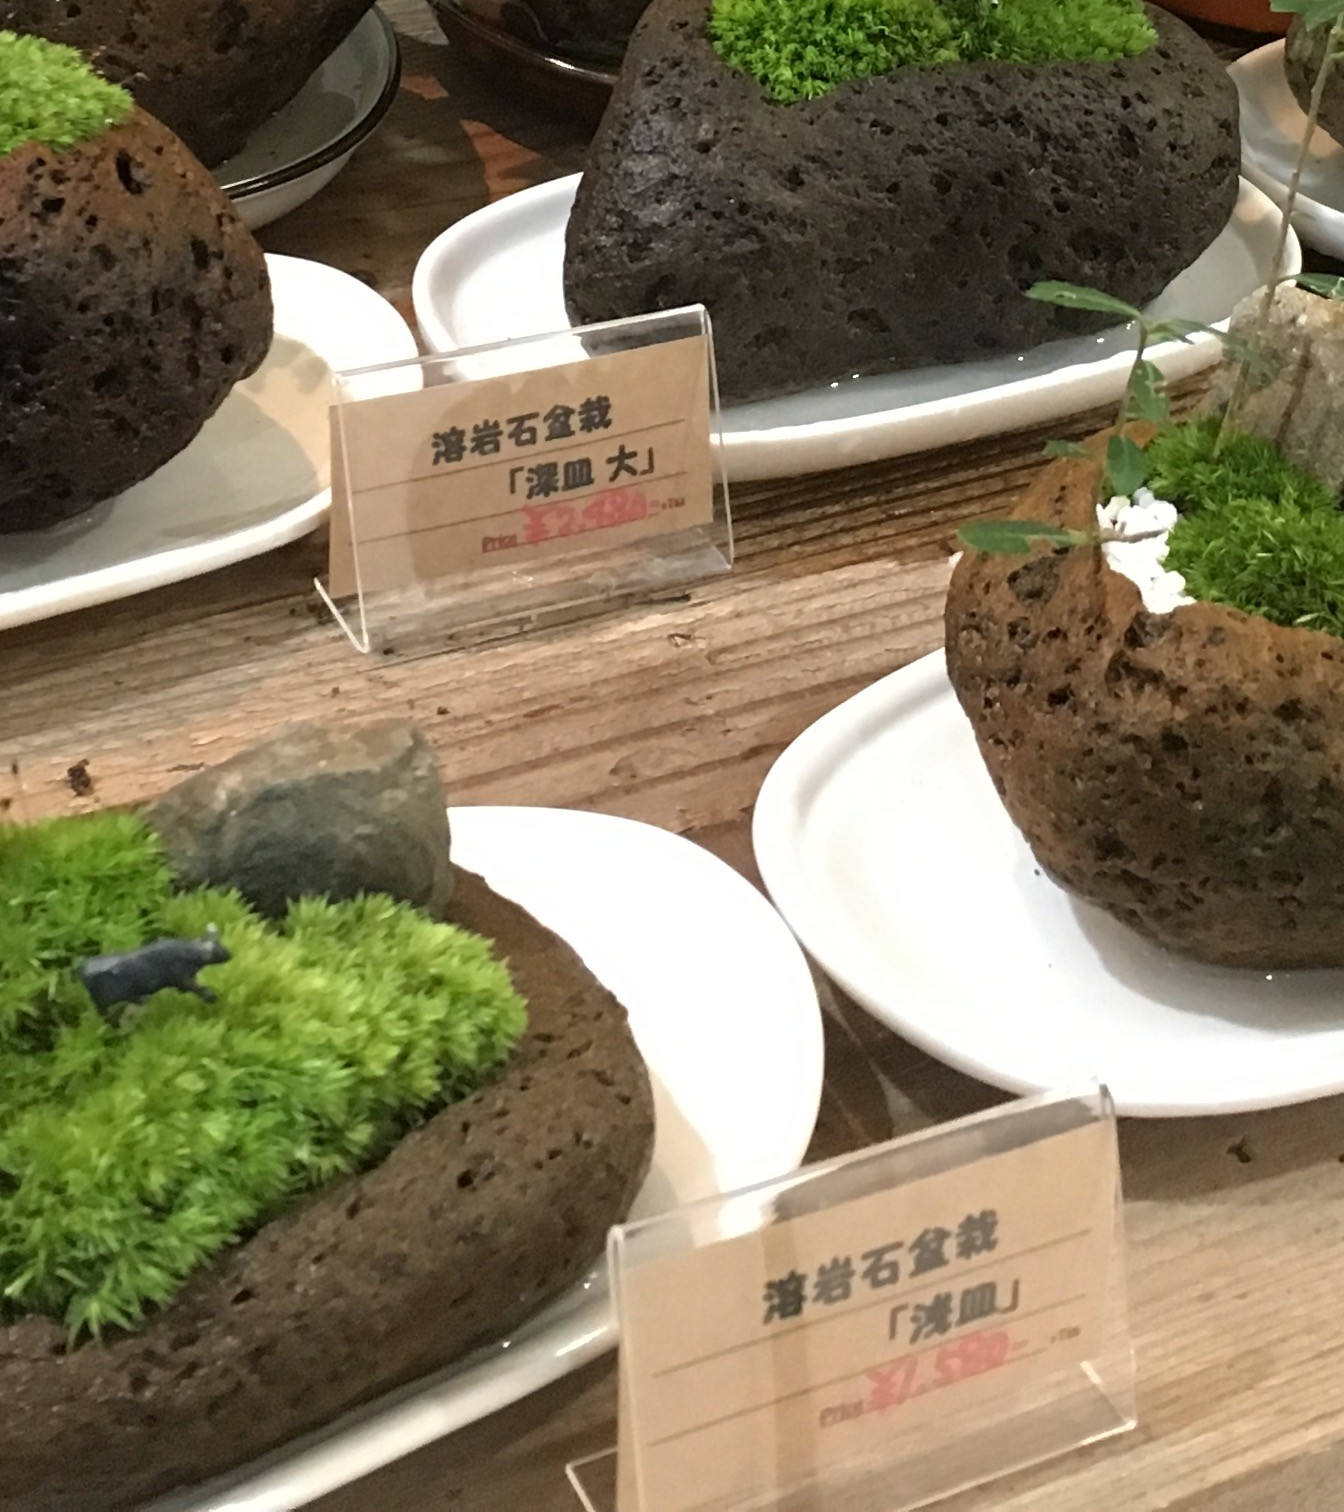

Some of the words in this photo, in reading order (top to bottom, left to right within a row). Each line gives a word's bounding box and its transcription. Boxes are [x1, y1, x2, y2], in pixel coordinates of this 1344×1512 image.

[431, 395, 613, 466] 溶岩石盆栽
[762, 1208, 999, 1326] 溶岩石盆栽
